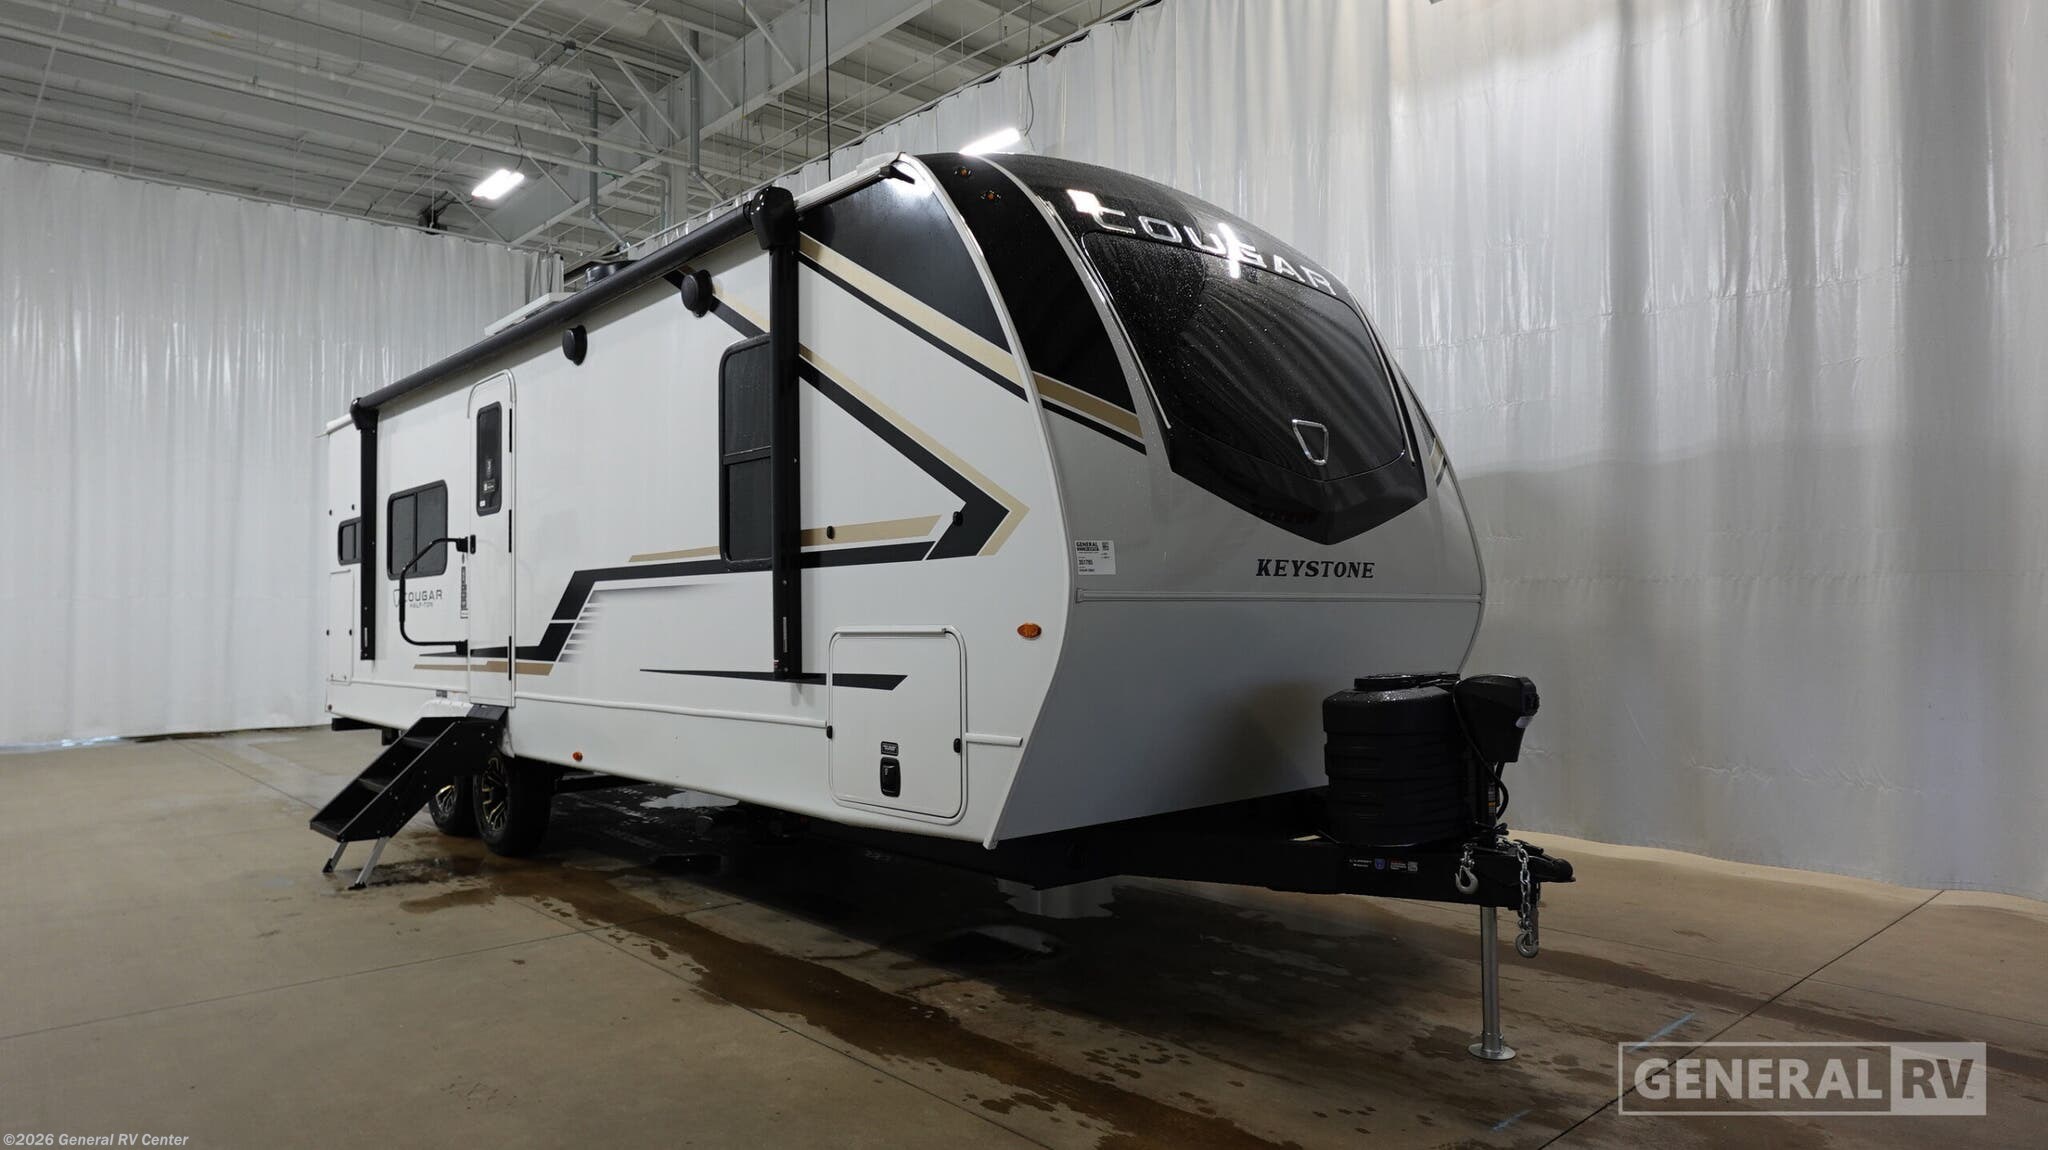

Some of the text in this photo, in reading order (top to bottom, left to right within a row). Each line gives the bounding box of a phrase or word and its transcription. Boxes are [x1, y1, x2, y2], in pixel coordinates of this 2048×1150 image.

[1093, 206, 1337, 296] COUGAR
[1255, 558, 1376, 579] KEYSTONE
[404, 589, 443, 602] OUGAR
